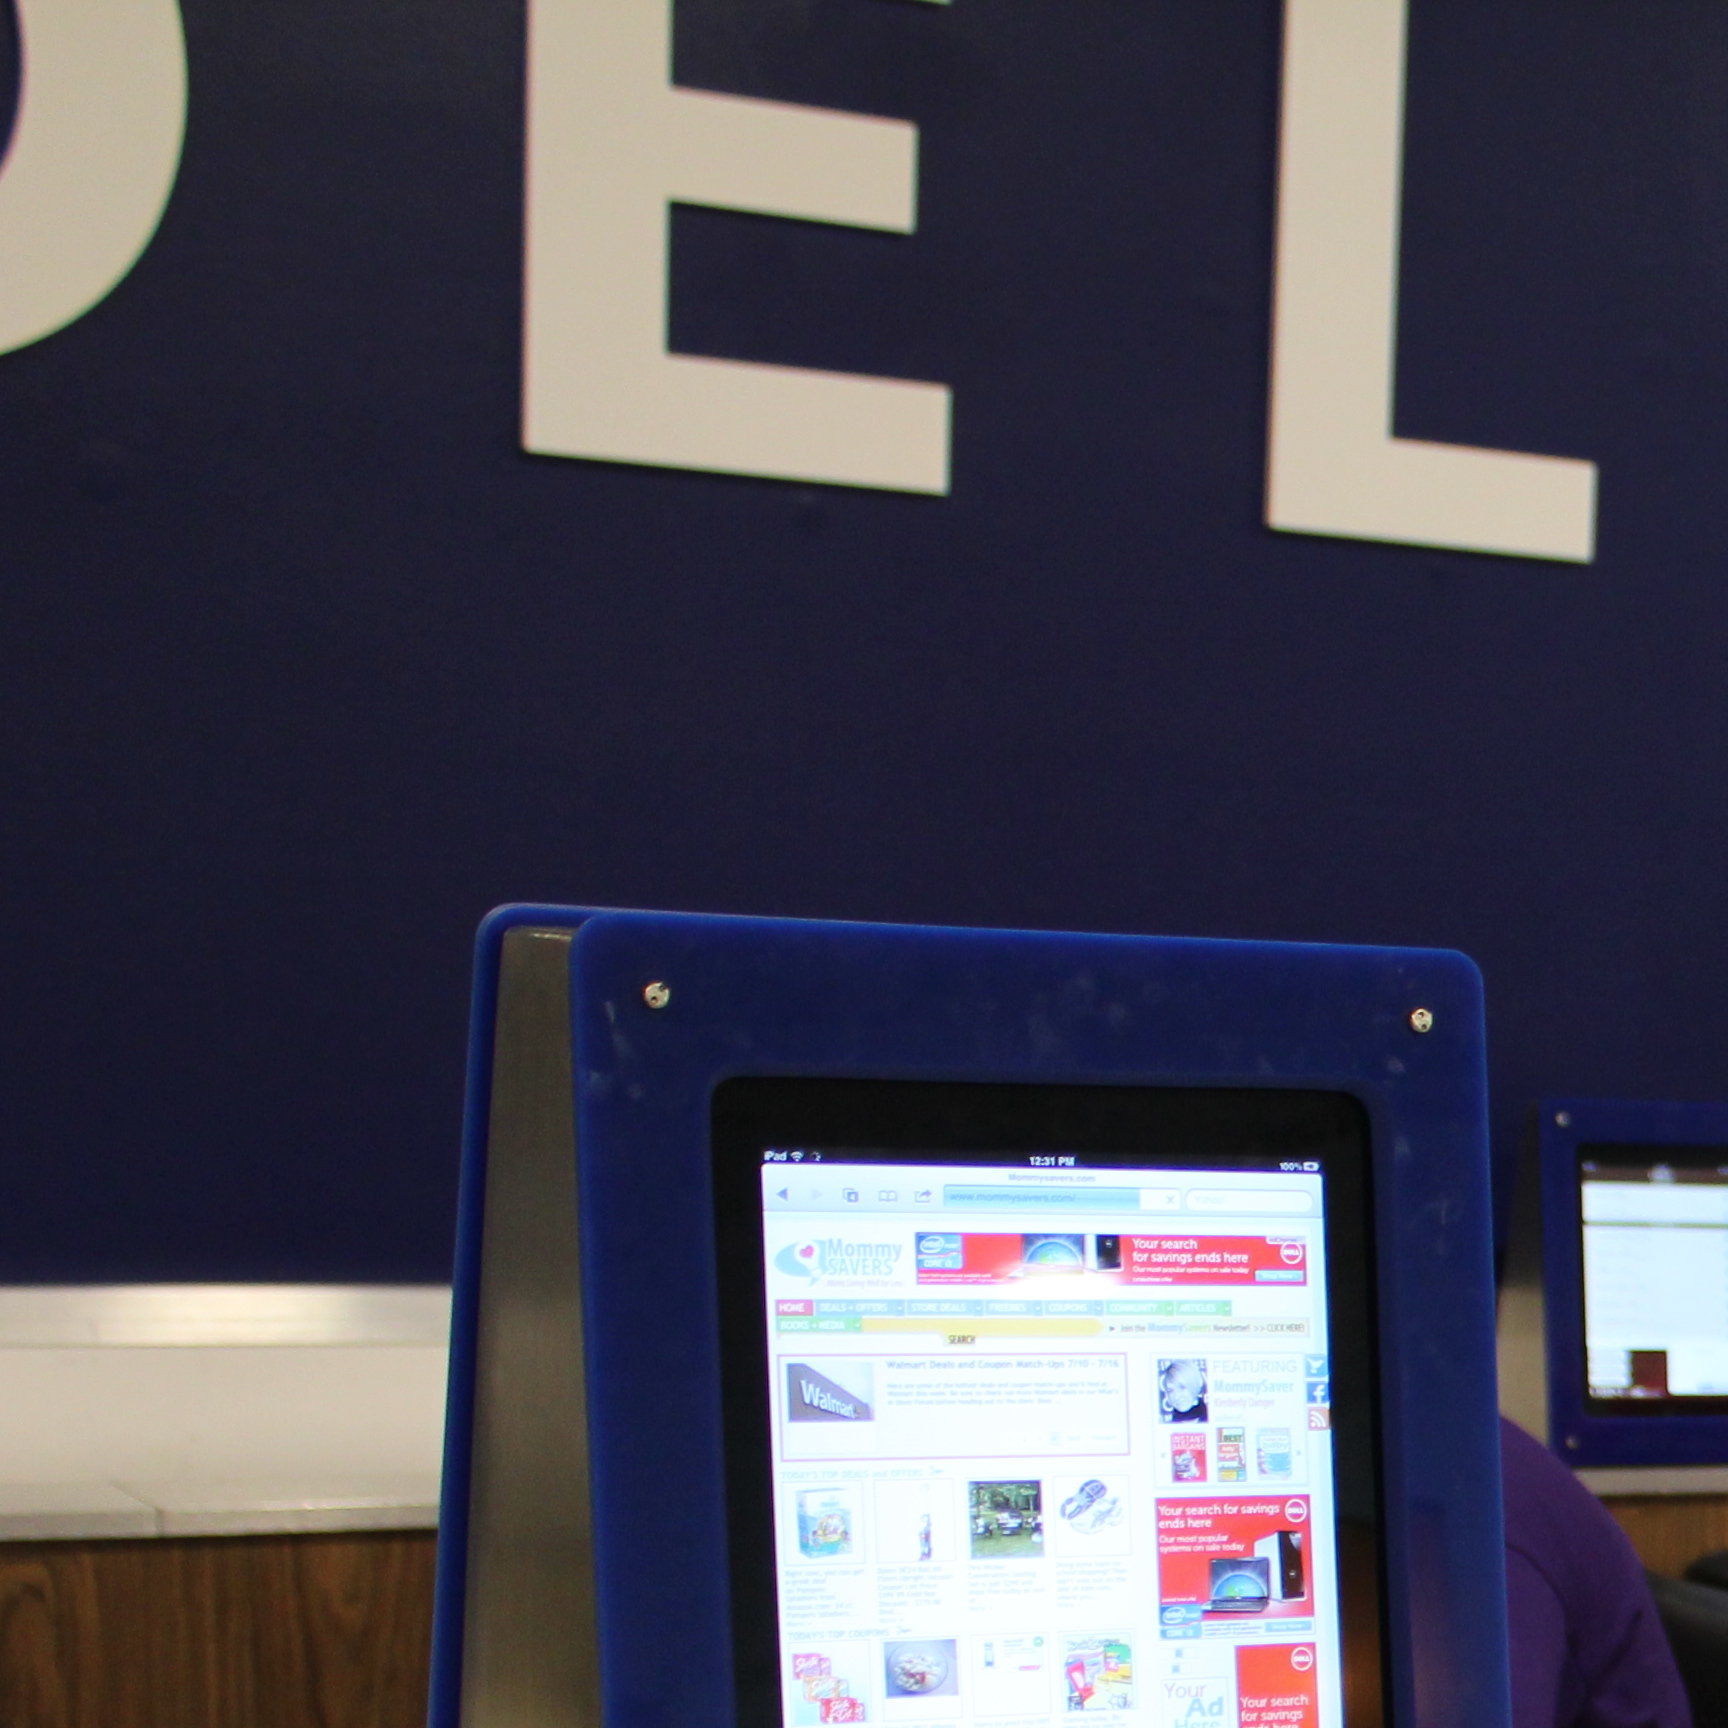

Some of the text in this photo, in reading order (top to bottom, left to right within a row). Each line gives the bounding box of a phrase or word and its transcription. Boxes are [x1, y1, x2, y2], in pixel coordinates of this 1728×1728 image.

[764, 1151, 787, 1162] iPad
[1029, 1156, 1055, 1166] 12:31
[1058, 1157, 1075, 1167] PM
[827, 1237, 903, 1264] Mommy
[1133, 1238, 1198, 1250] Your search
[1133, 1251, 1249, 1265] for savings ends here
[827, 1258, 893, 1277] SAVERS
[778, 1303, 805, 1312] HOME
[819, 1303, 846, 1312] DEALS
[911, 1303, 966, 1312] STORE DEALS
[1049, 1303, 1087, 1312] COUPONS
[780, 1320, 810, 1330] BOOKS
[819, 1320, 845, 1330] MEDIA
[886, 1360, 926, 1370] Walmart
[929, 1360, 955, 1370] Deals
[957, 1360, 975, 1370] and
[978, 1360, 1013, 1371] Coupon
[1212, 1359, 1298, 1373] FEATURING
[1213, 1379, 1295, 1395] MommySaver
[801, 1378, 857, 1419] Walmart
[781, 1470, 817, 1480] TODAY'S
[820, 1470, 840, 1480] TOP
[841, 1469, 870, 1479] DEALS
[1158, 1502, 1280, 1517] Your search for savings
[1158, 1517, 1212, 1530] ends here
[787, 1631, 824, 1641] TODAY'S
[828, 1630, 845, 1639] TOP
[1163, 1682, 1207, 1700] Your
[1185, 1696, 1225, 1719] Ad
[1240, 1693, 1309, 1709] Your search
[1241, 1710, 1303, 1723] for savings
